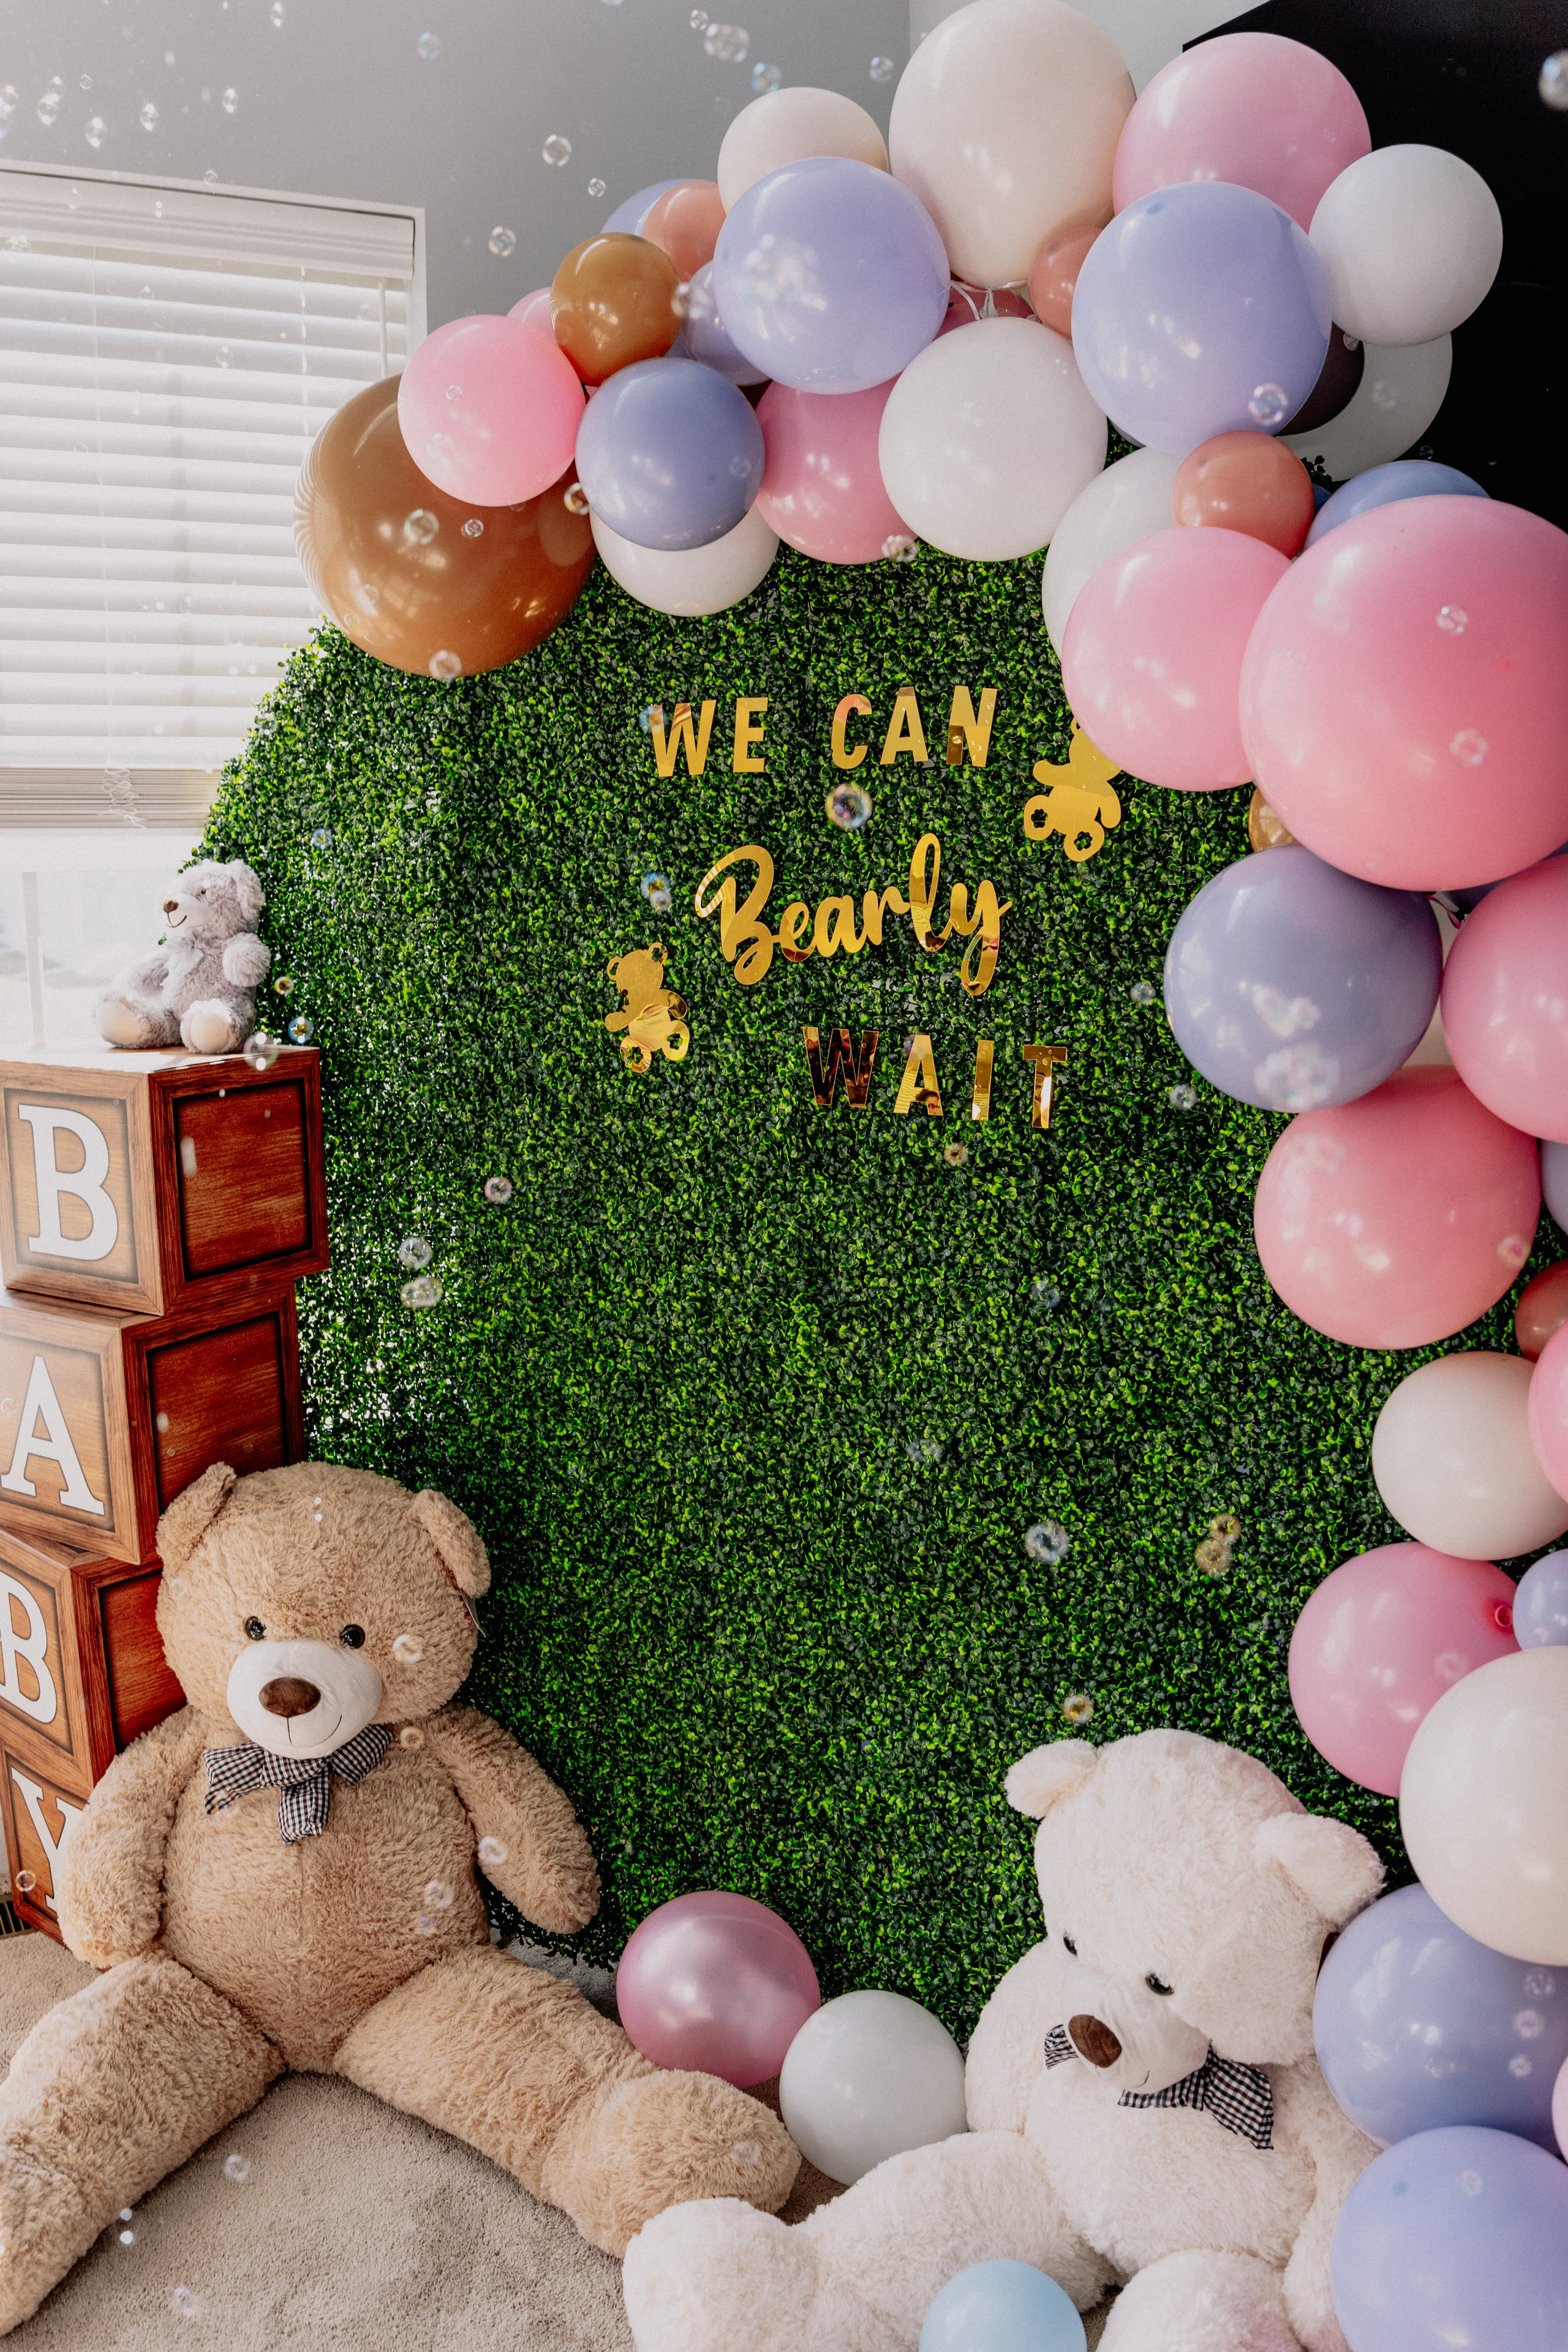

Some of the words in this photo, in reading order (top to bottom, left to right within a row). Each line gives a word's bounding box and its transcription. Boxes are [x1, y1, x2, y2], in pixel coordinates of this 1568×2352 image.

[649, 697, 769, 777] WE
[831, 685, 998, 769] CAN
[695, 832, 1013, 996] Bearly
[804, 1027, 1068, 1128] WAIT
